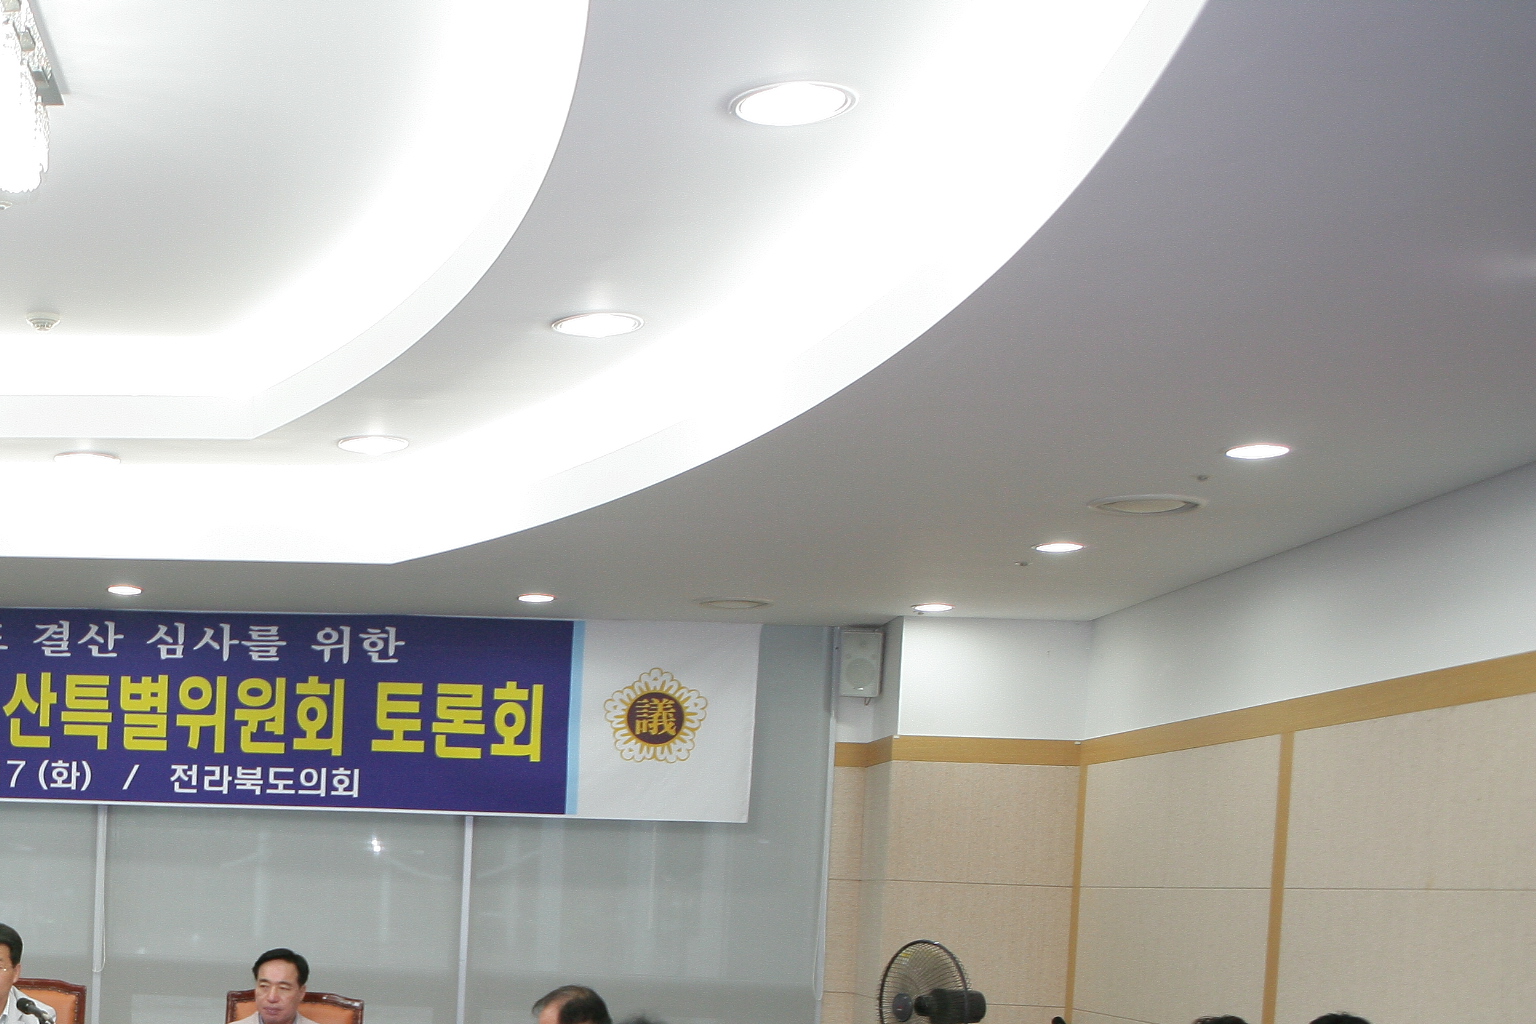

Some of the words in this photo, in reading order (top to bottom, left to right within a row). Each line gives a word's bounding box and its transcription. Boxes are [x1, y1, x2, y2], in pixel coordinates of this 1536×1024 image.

[32, 621, 125, 658] 결산
[146, 622, 287, 663] 심사를
[311, 625, 406, 665] 위한
[371, 681, 545, 763] 토론회
[170, 764, 360, 798] 전라북도의회
